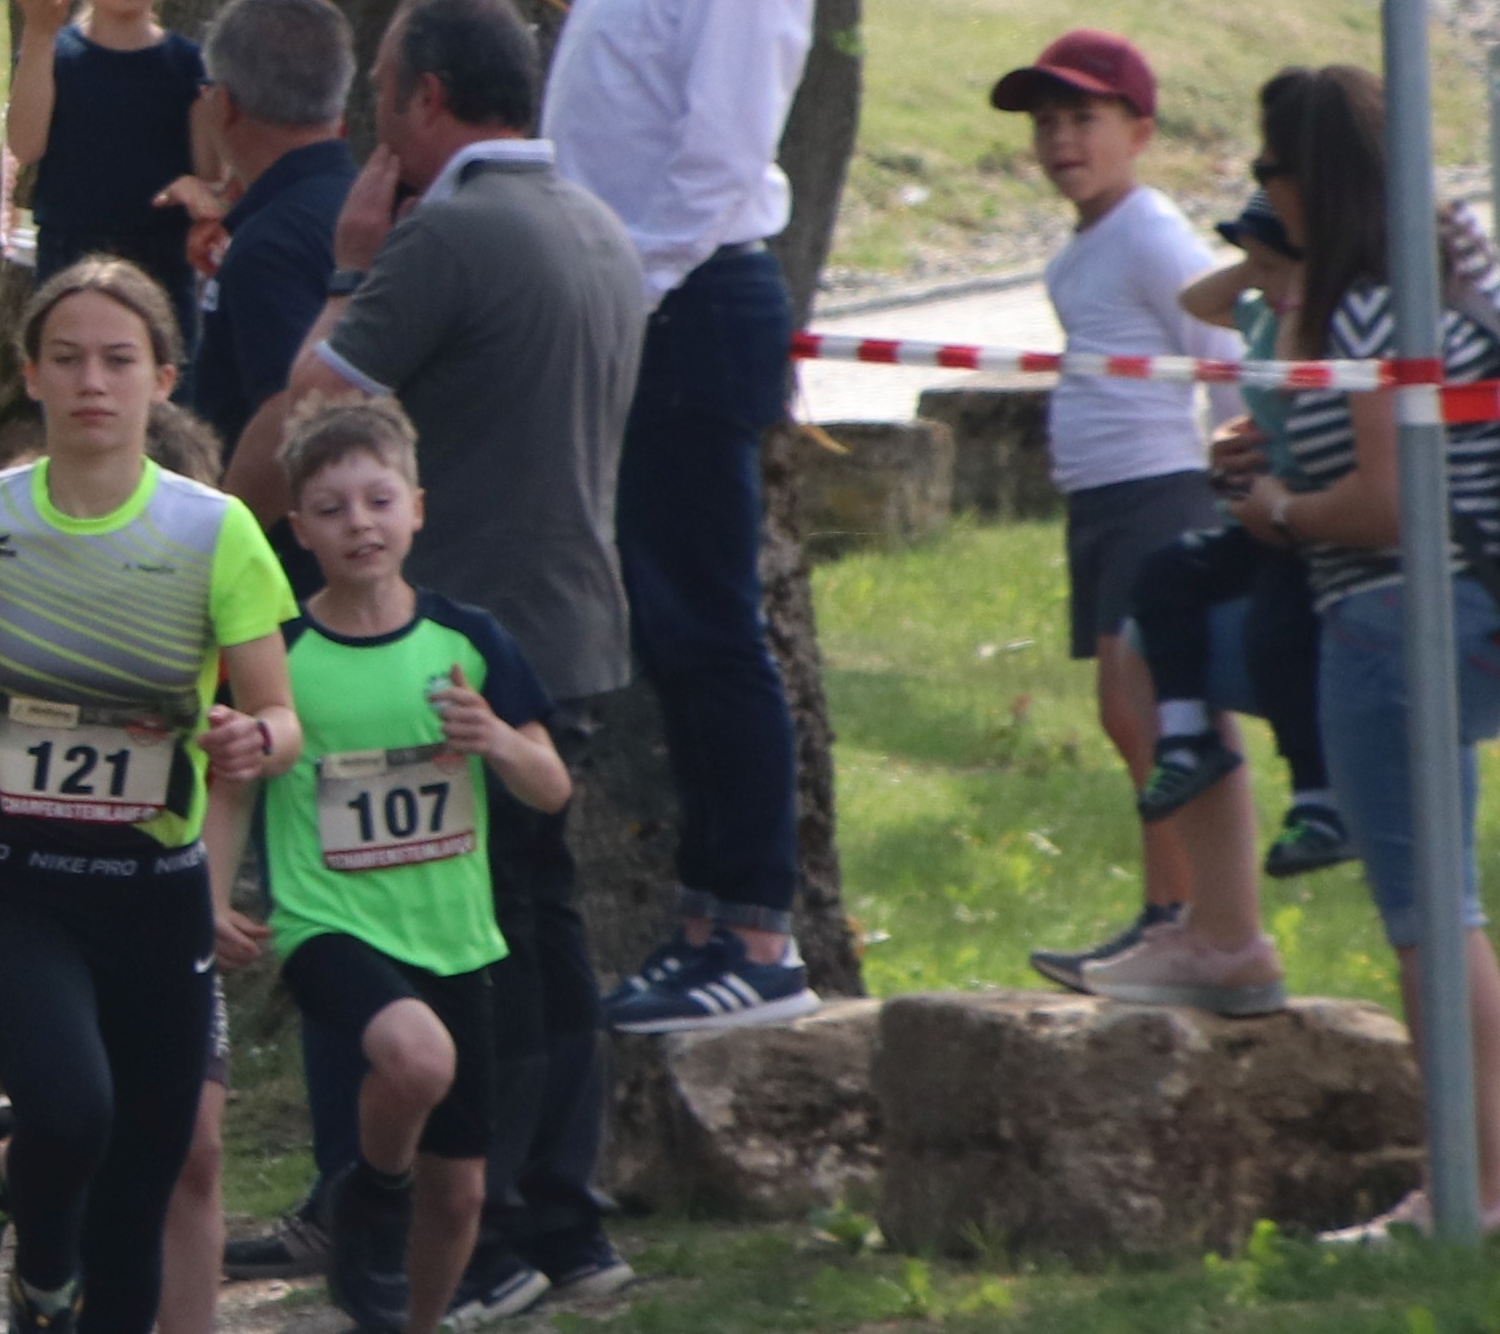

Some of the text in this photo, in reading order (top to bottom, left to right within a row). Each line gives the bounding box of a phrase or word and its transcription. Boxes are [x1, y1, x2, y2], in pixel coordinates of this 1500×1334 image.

[28, 741, 130, 797] 121
[348, 782, 449, 841] 107
[29, 851, 138, 876] NIKE PRO
